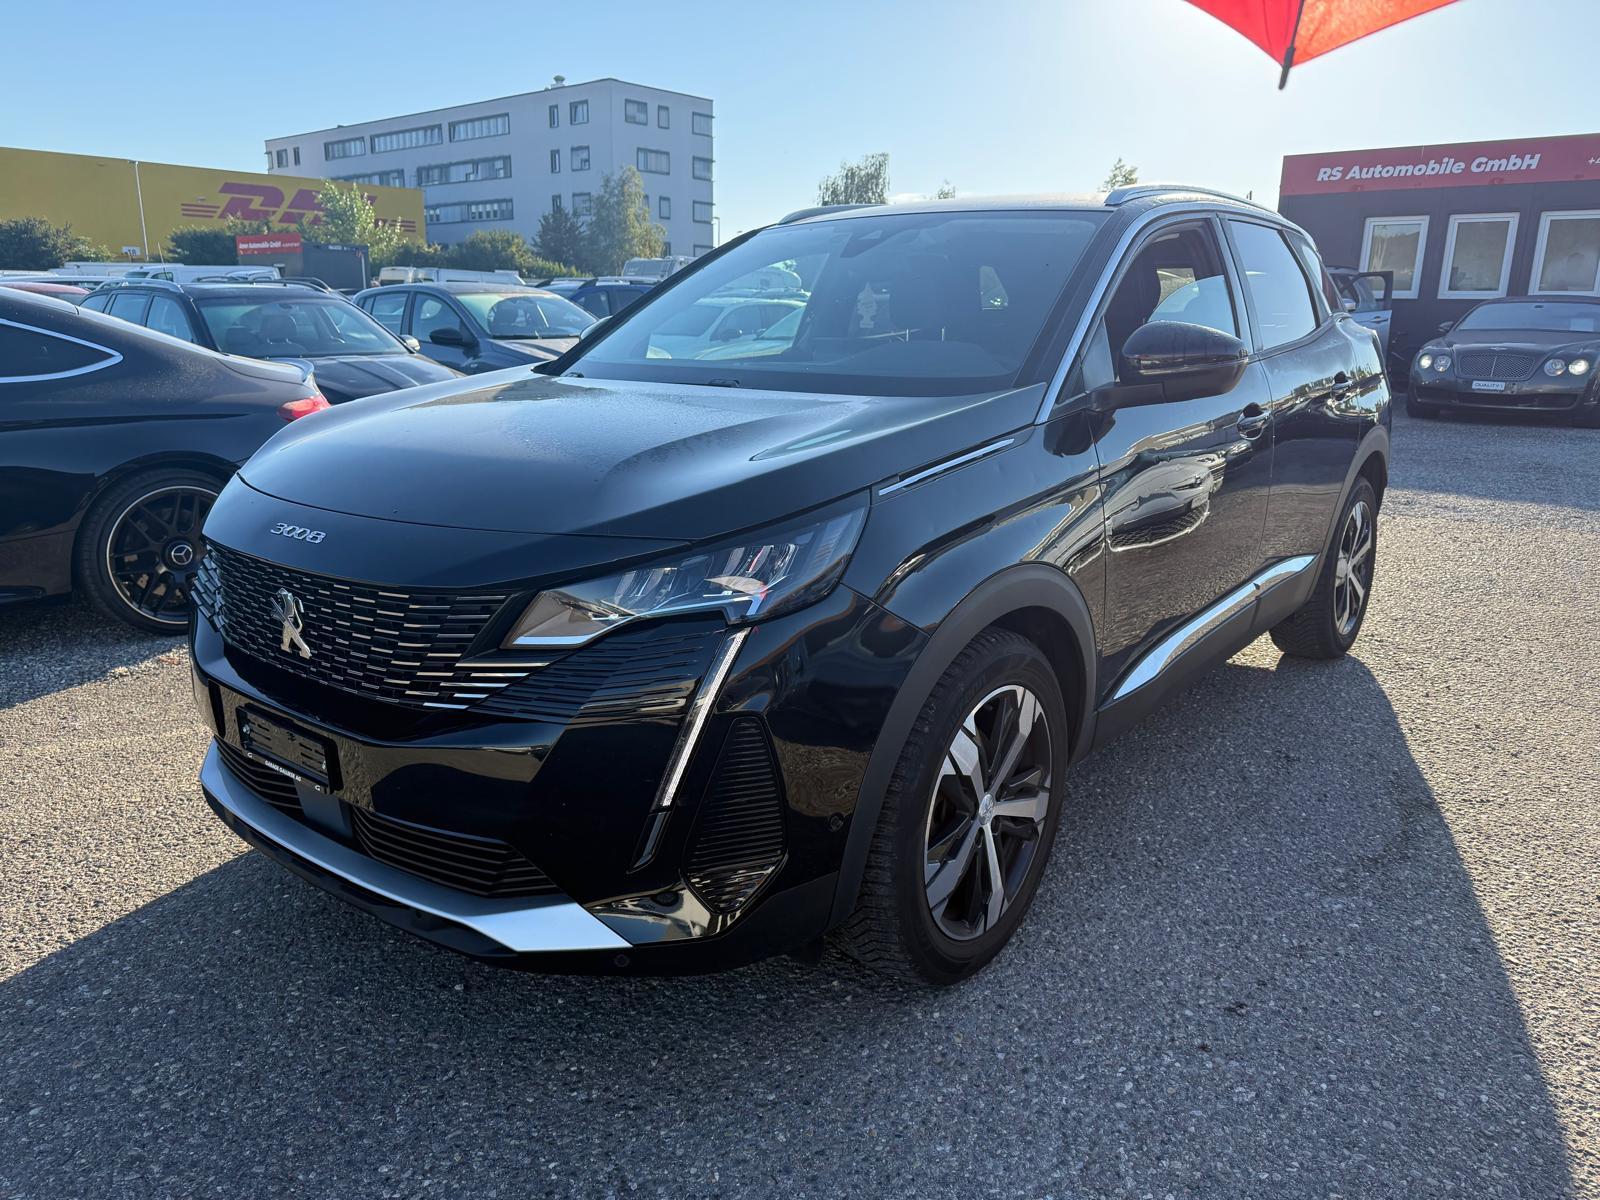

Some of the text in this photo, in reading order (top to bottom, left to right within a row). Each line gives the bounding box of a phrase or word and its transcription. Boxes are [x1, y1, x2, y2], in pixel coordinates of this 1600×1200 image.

[1317, 153, 1541, 182] RS Automobile GmbH
[270, 522, 327, 544] 3008
